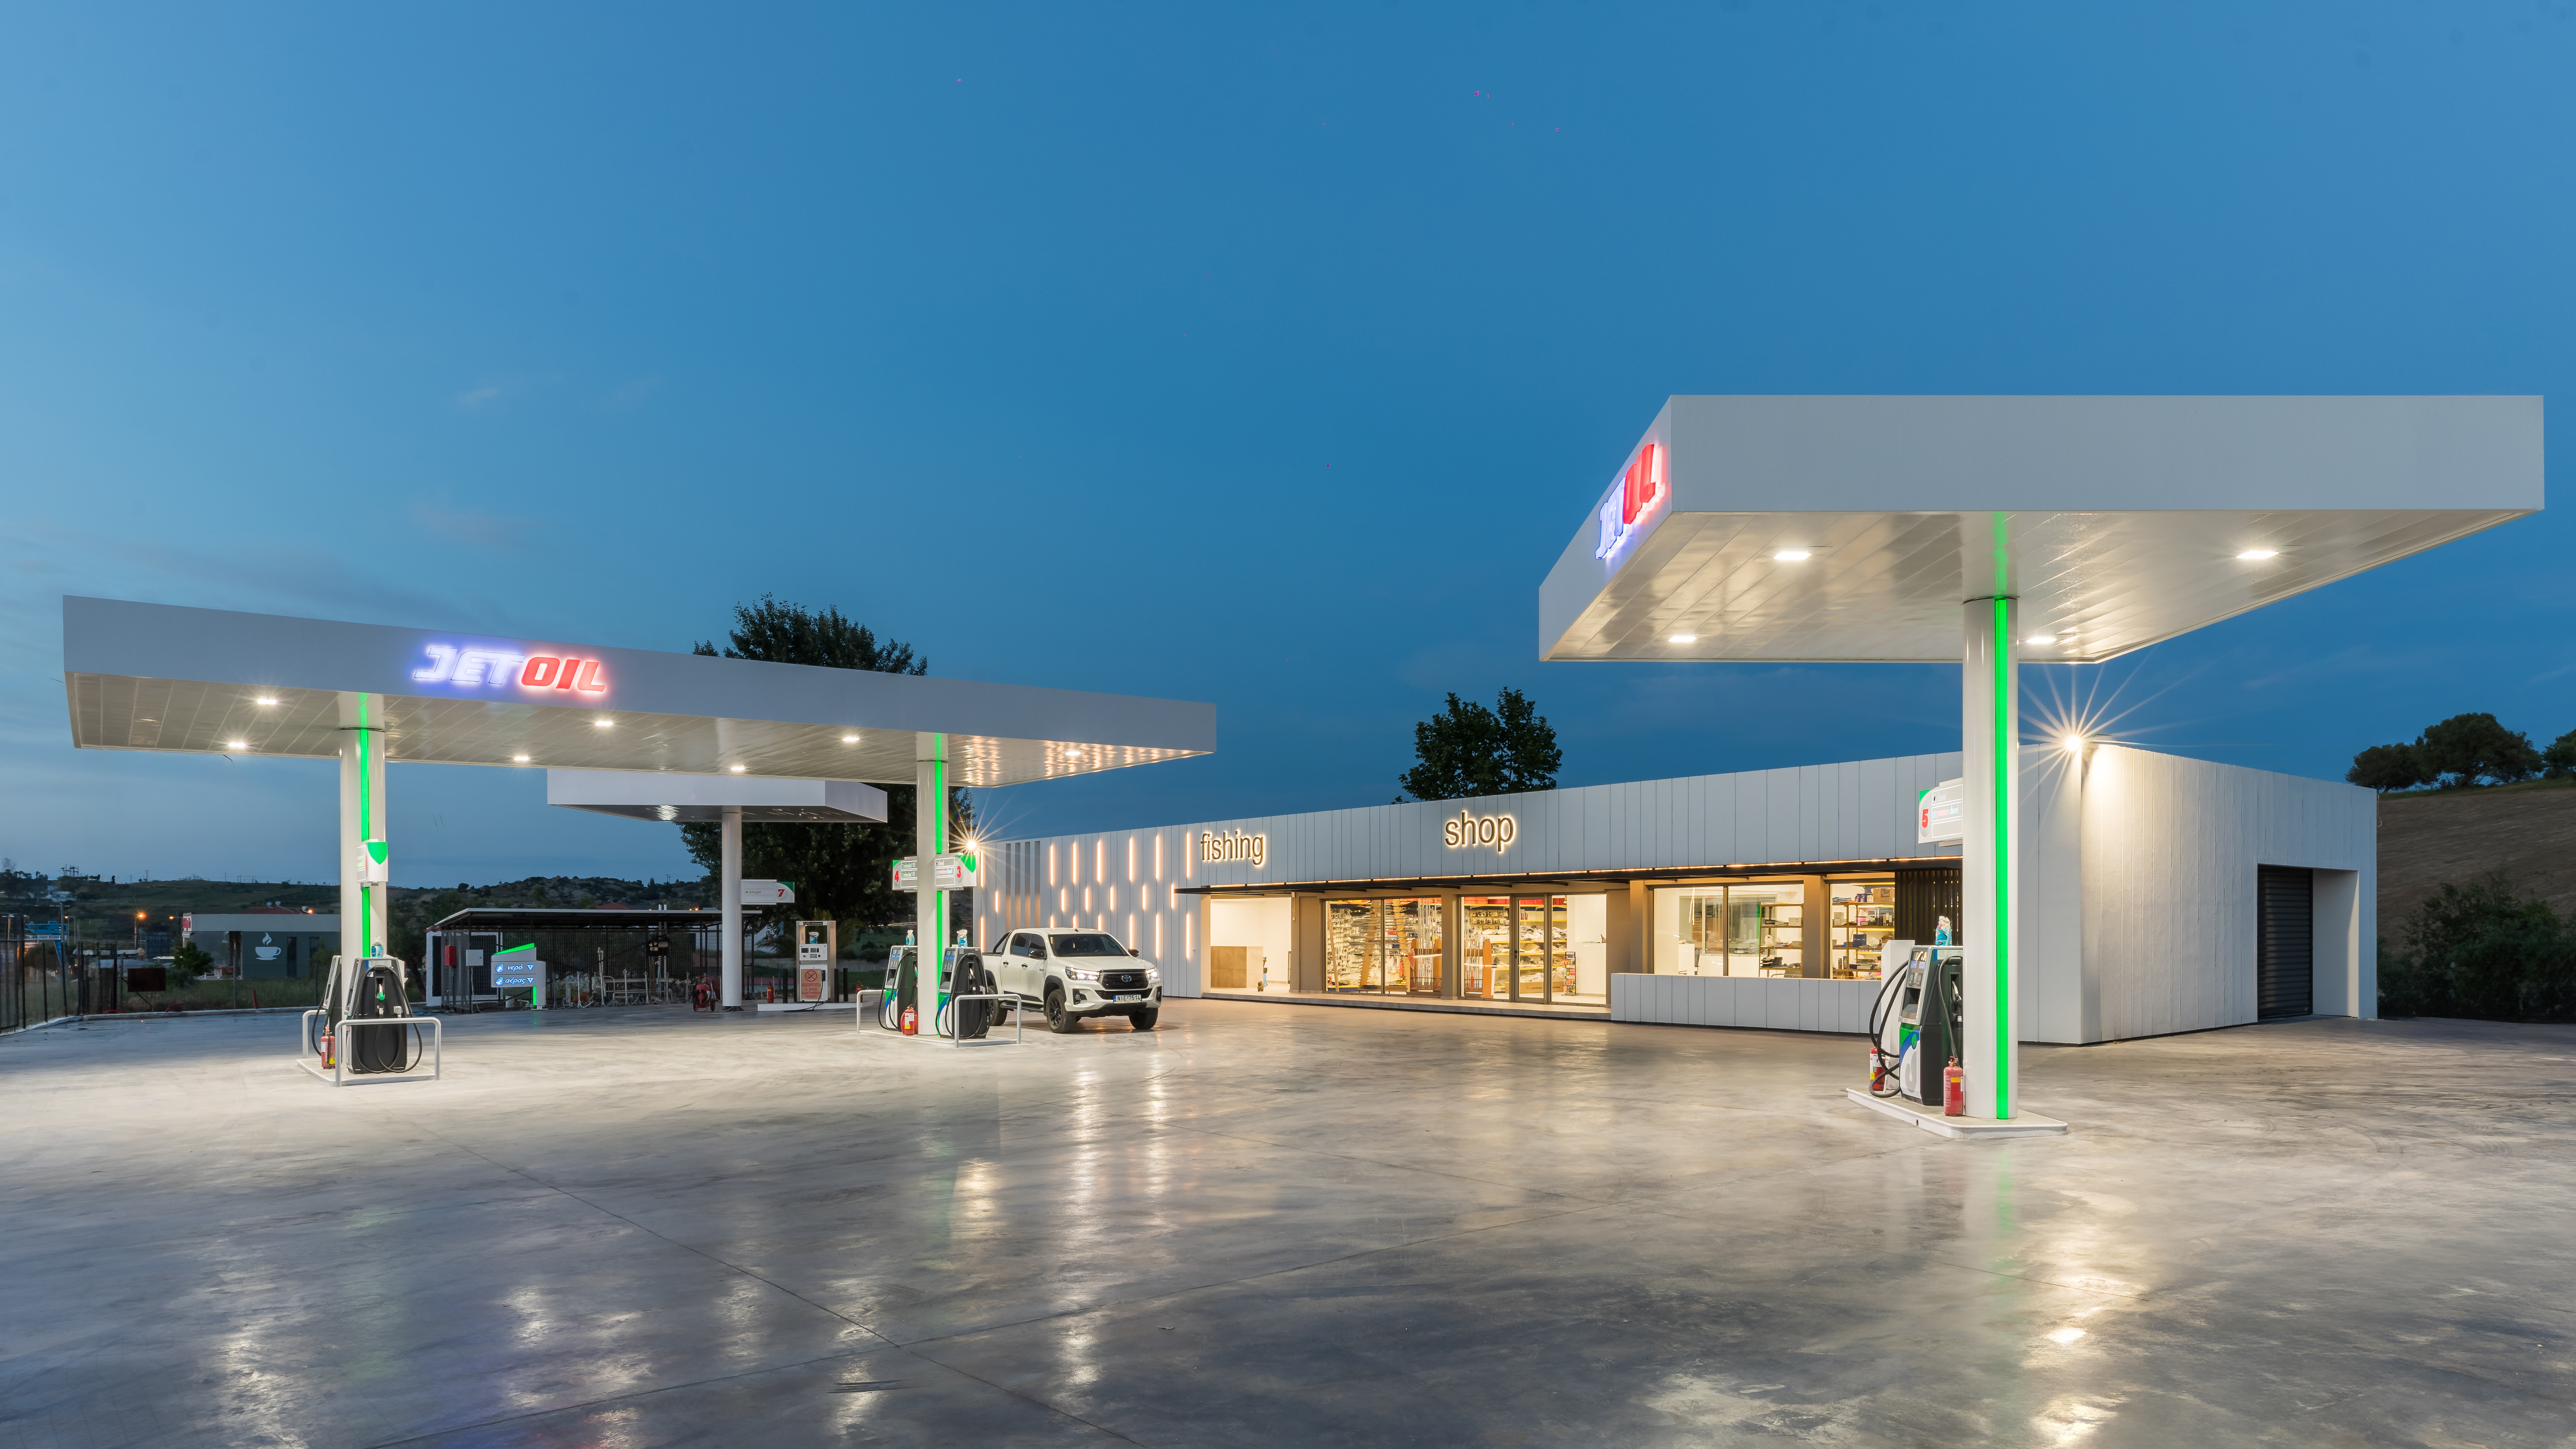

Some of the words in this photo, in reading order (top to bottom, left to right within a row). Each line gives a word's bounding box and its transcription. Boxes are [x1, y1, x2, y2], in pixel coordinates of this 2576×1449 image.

[414, 647, 605, 692] JETOIL
[1949, 803, 1959, 815] diesel
[1922, 808, 1928, 828] 5
[1445, 812, 1514, 852] shop
[1200, 830, 1263, 865] fishing
[894, 871, 899, 882] 4
[957, 865, 961, 878] 3
[778, 889, 785, 897] 7
